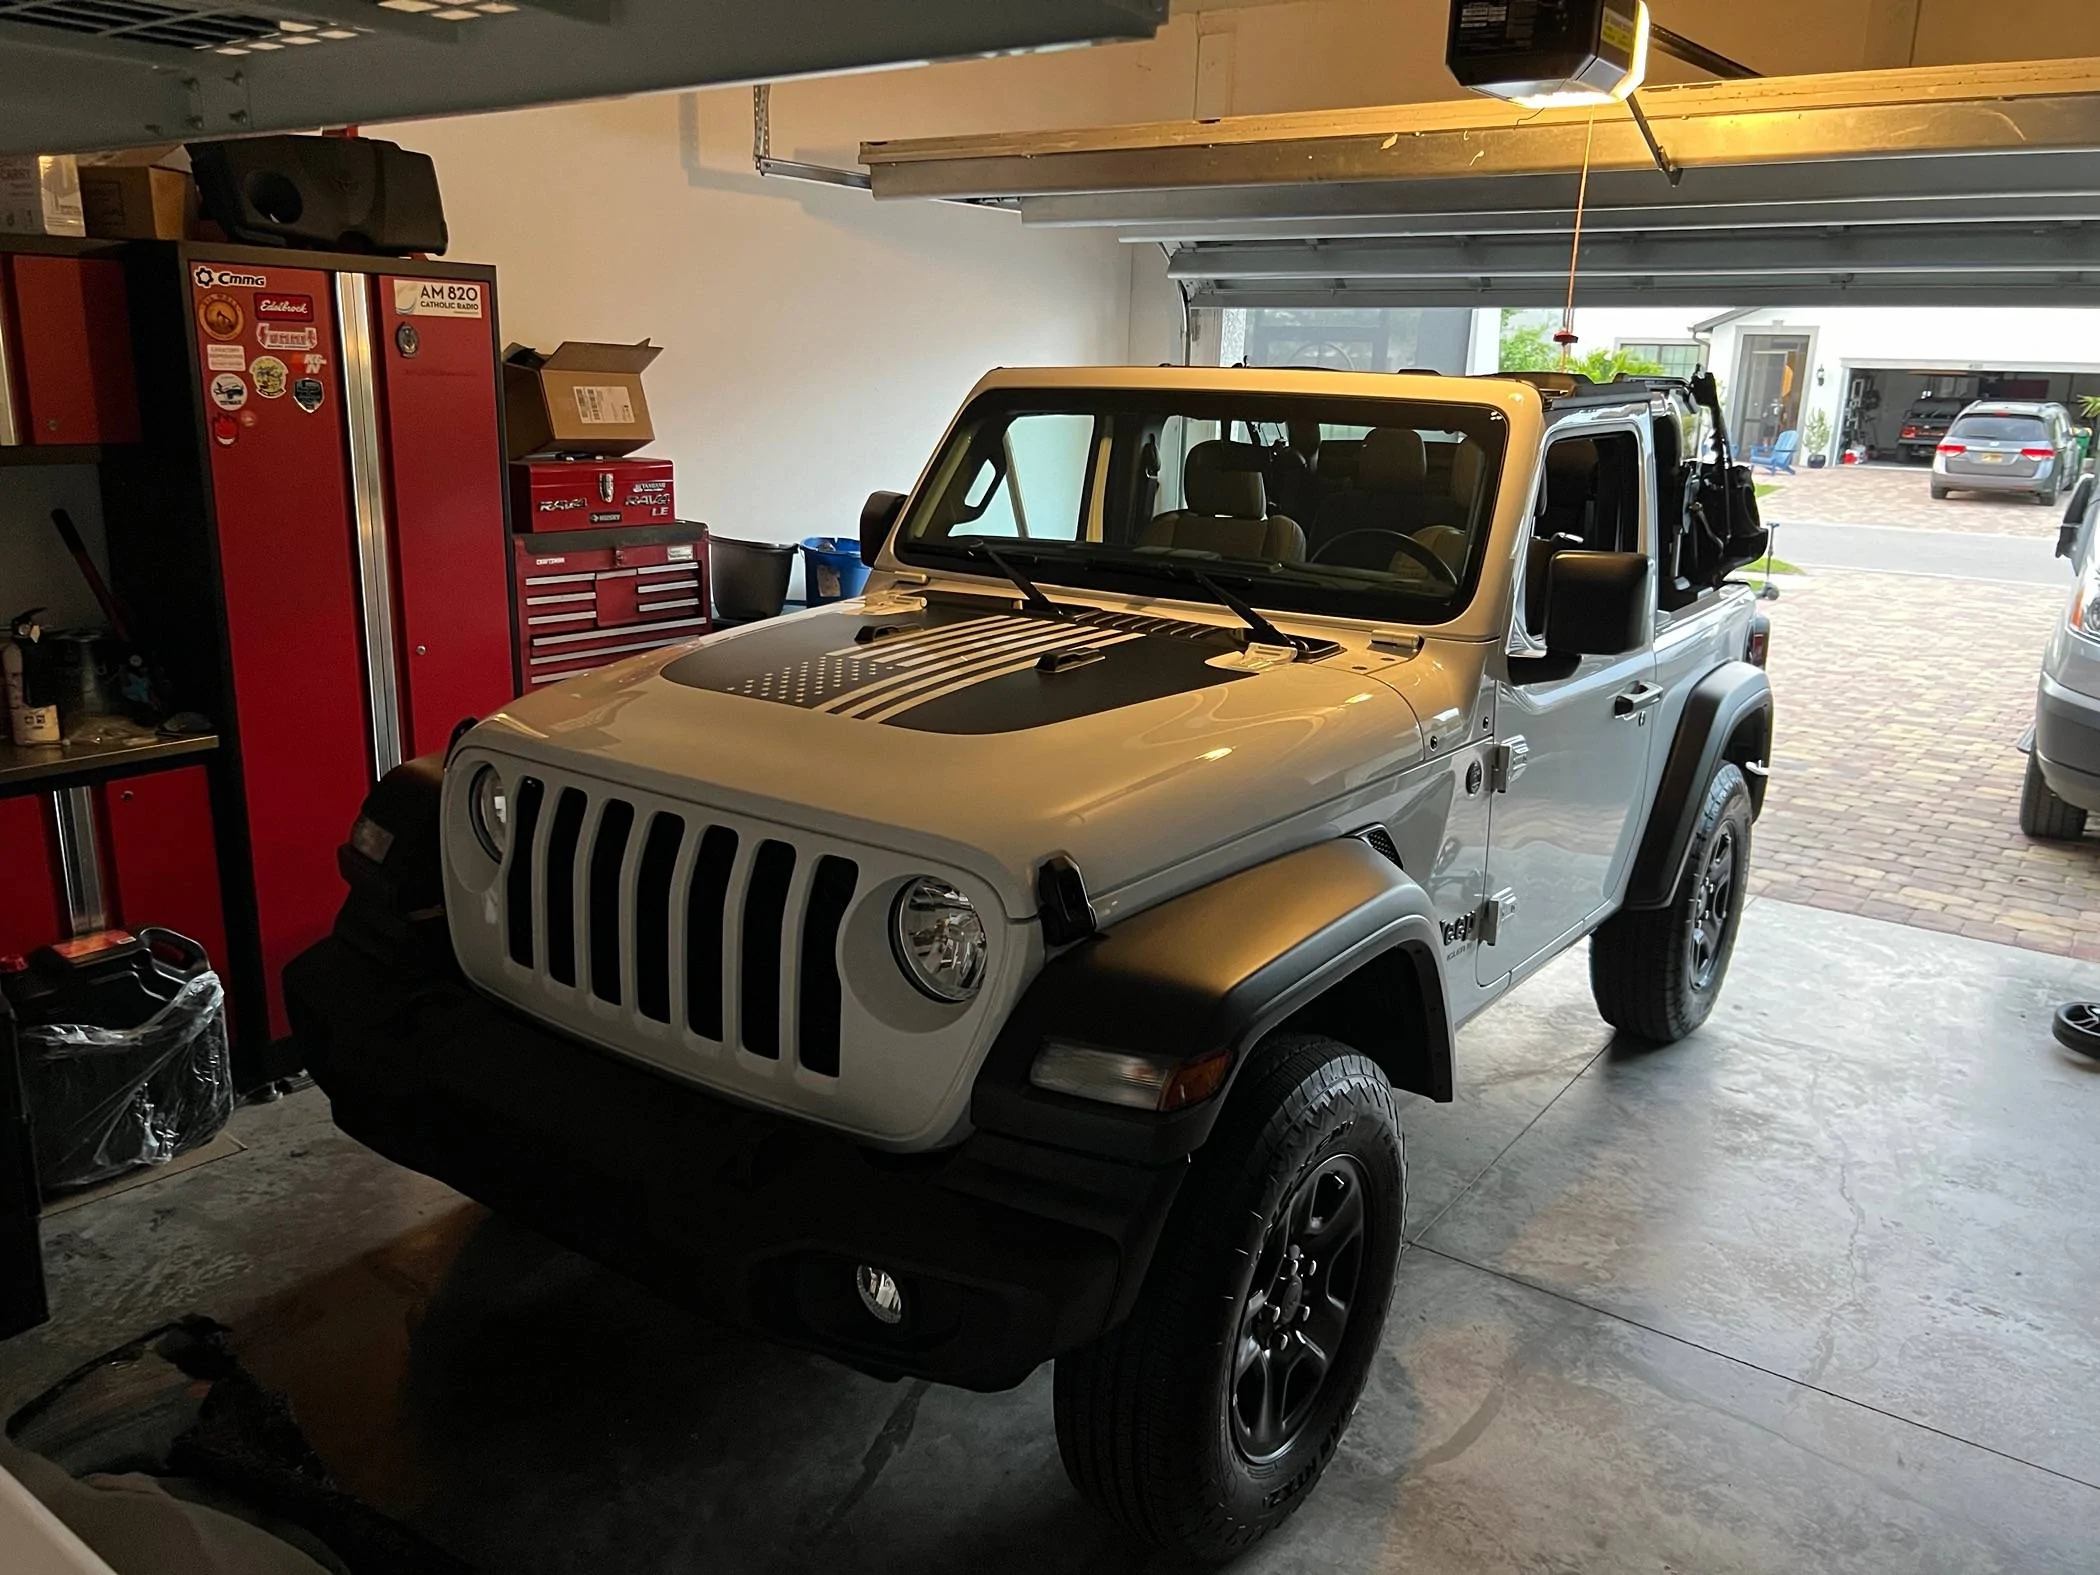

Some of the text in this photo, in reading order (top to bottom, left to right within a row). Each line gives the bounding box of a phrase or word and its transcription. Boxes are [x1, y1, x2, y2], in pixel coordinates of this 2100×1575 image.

[420, 285, 478, 301] AM 820
[260, 300, 308, 313] Edelbrock
[420, 301, 455, 309] CATHOLIC
[652, 507, 669, 516] LE
